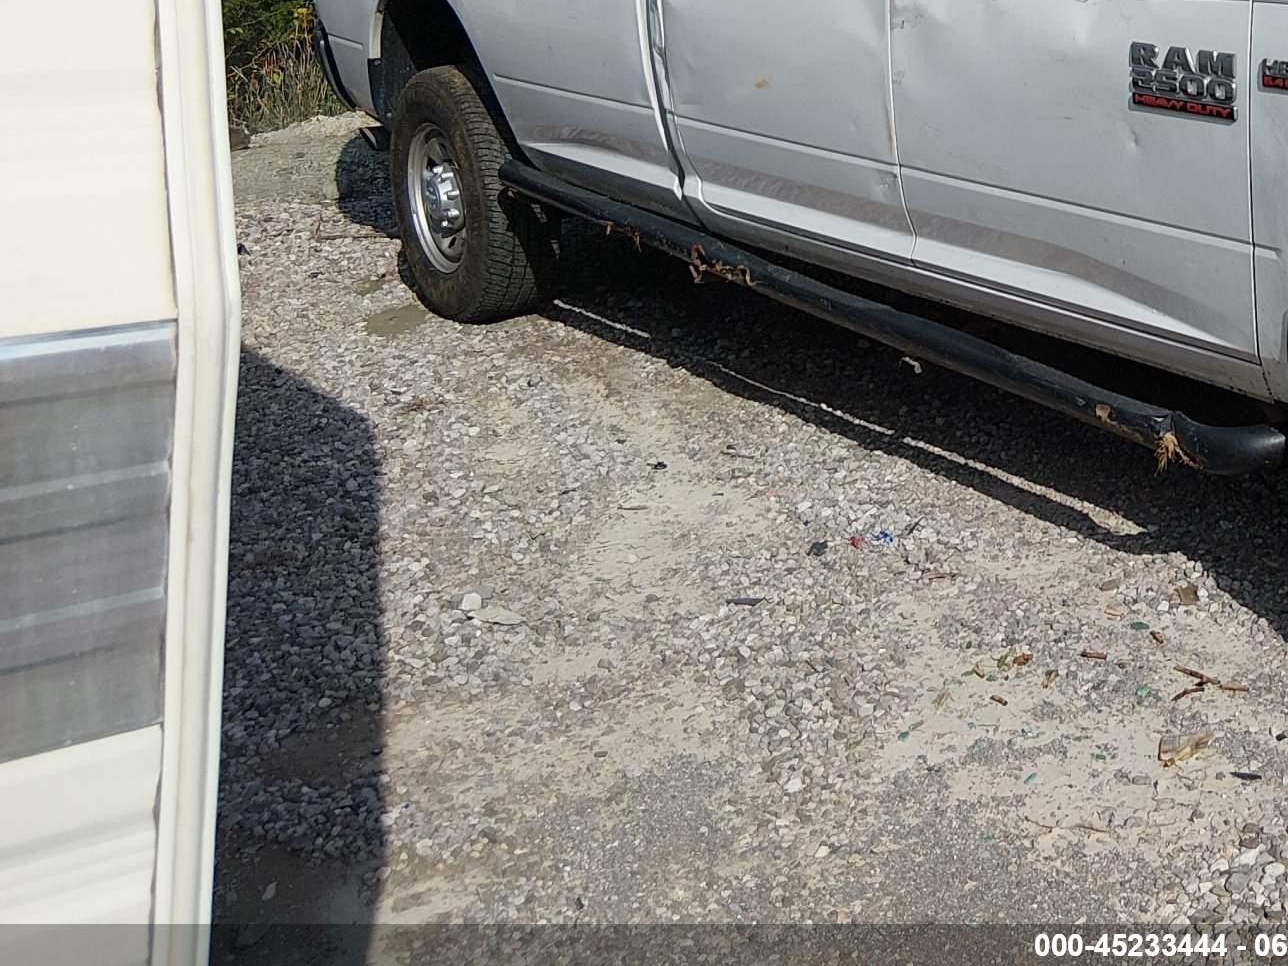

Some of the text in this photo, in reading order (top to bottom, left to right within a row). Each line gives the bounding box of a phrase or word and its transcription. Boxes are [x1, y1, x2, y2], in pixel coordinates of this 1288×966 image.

[1129, 41, 1236, 79] RAM
[1130, 67, 1236, 105] 2500
[1135, 94, 1231, 117] HEAVY DUTY
